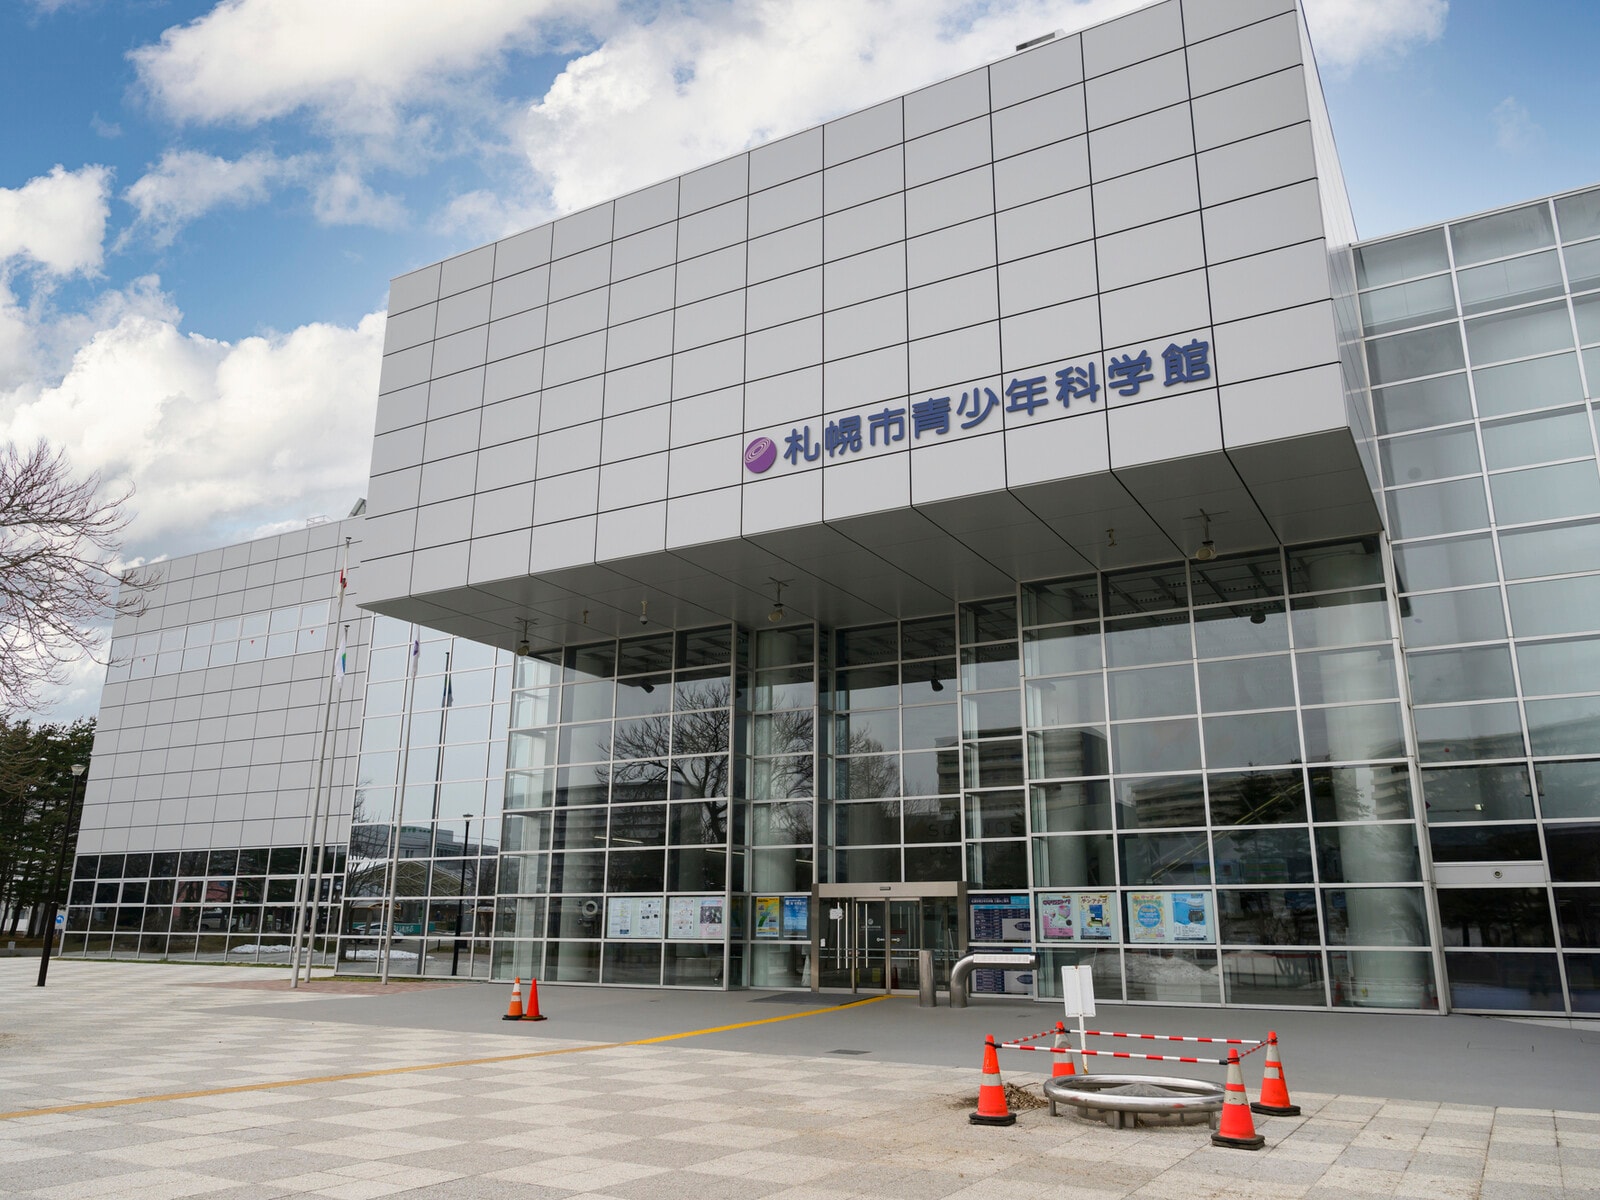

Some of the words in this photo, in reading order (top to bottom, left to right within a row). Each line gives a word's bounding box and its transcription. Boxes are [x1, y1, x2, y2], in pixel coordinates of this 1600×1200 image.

[784, 338, 1212, 466] 札幌市青少年科学館
